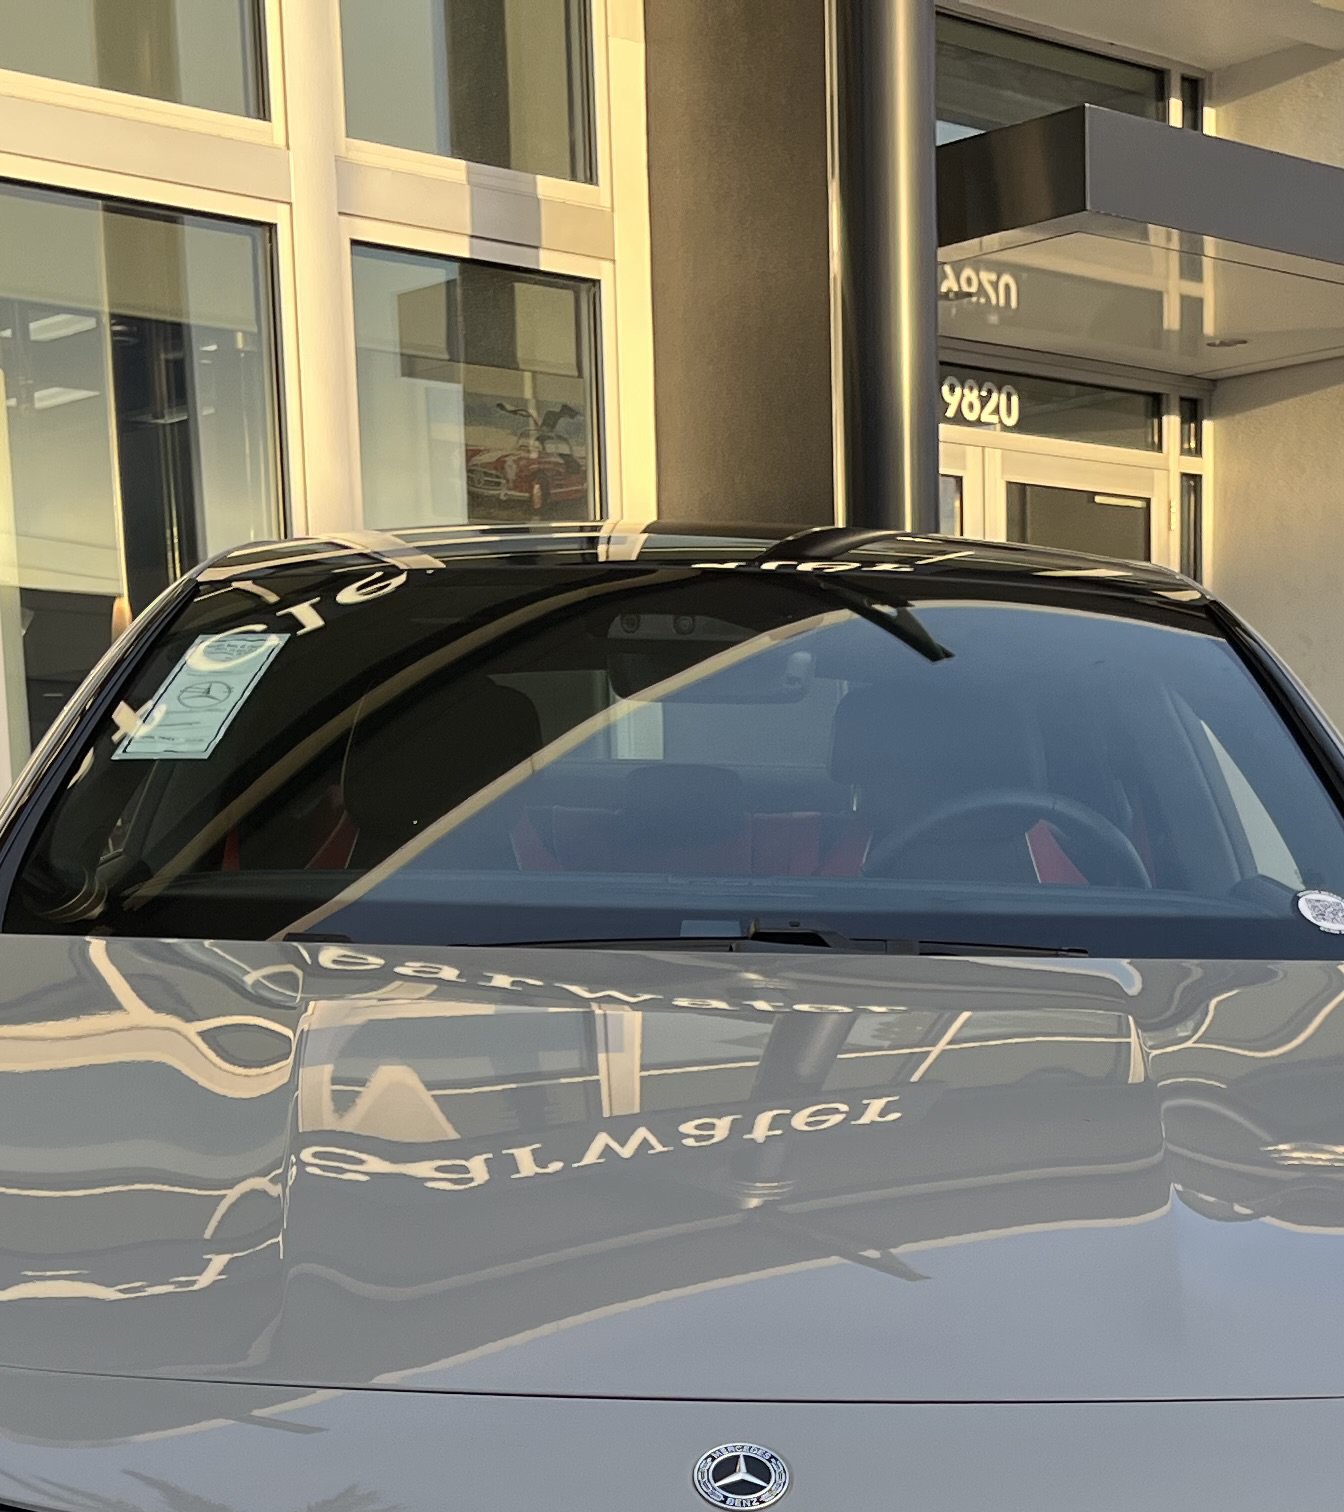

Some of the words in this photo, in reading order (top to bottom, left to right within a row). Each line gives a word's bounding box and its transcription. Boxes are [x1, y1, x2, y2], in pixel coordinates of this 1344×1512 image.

[941, 375, 1019, 427] 9820
[711, 1445, 772, 1459] MERCEDES
[725, 1497, 760, 1508] BENZ
